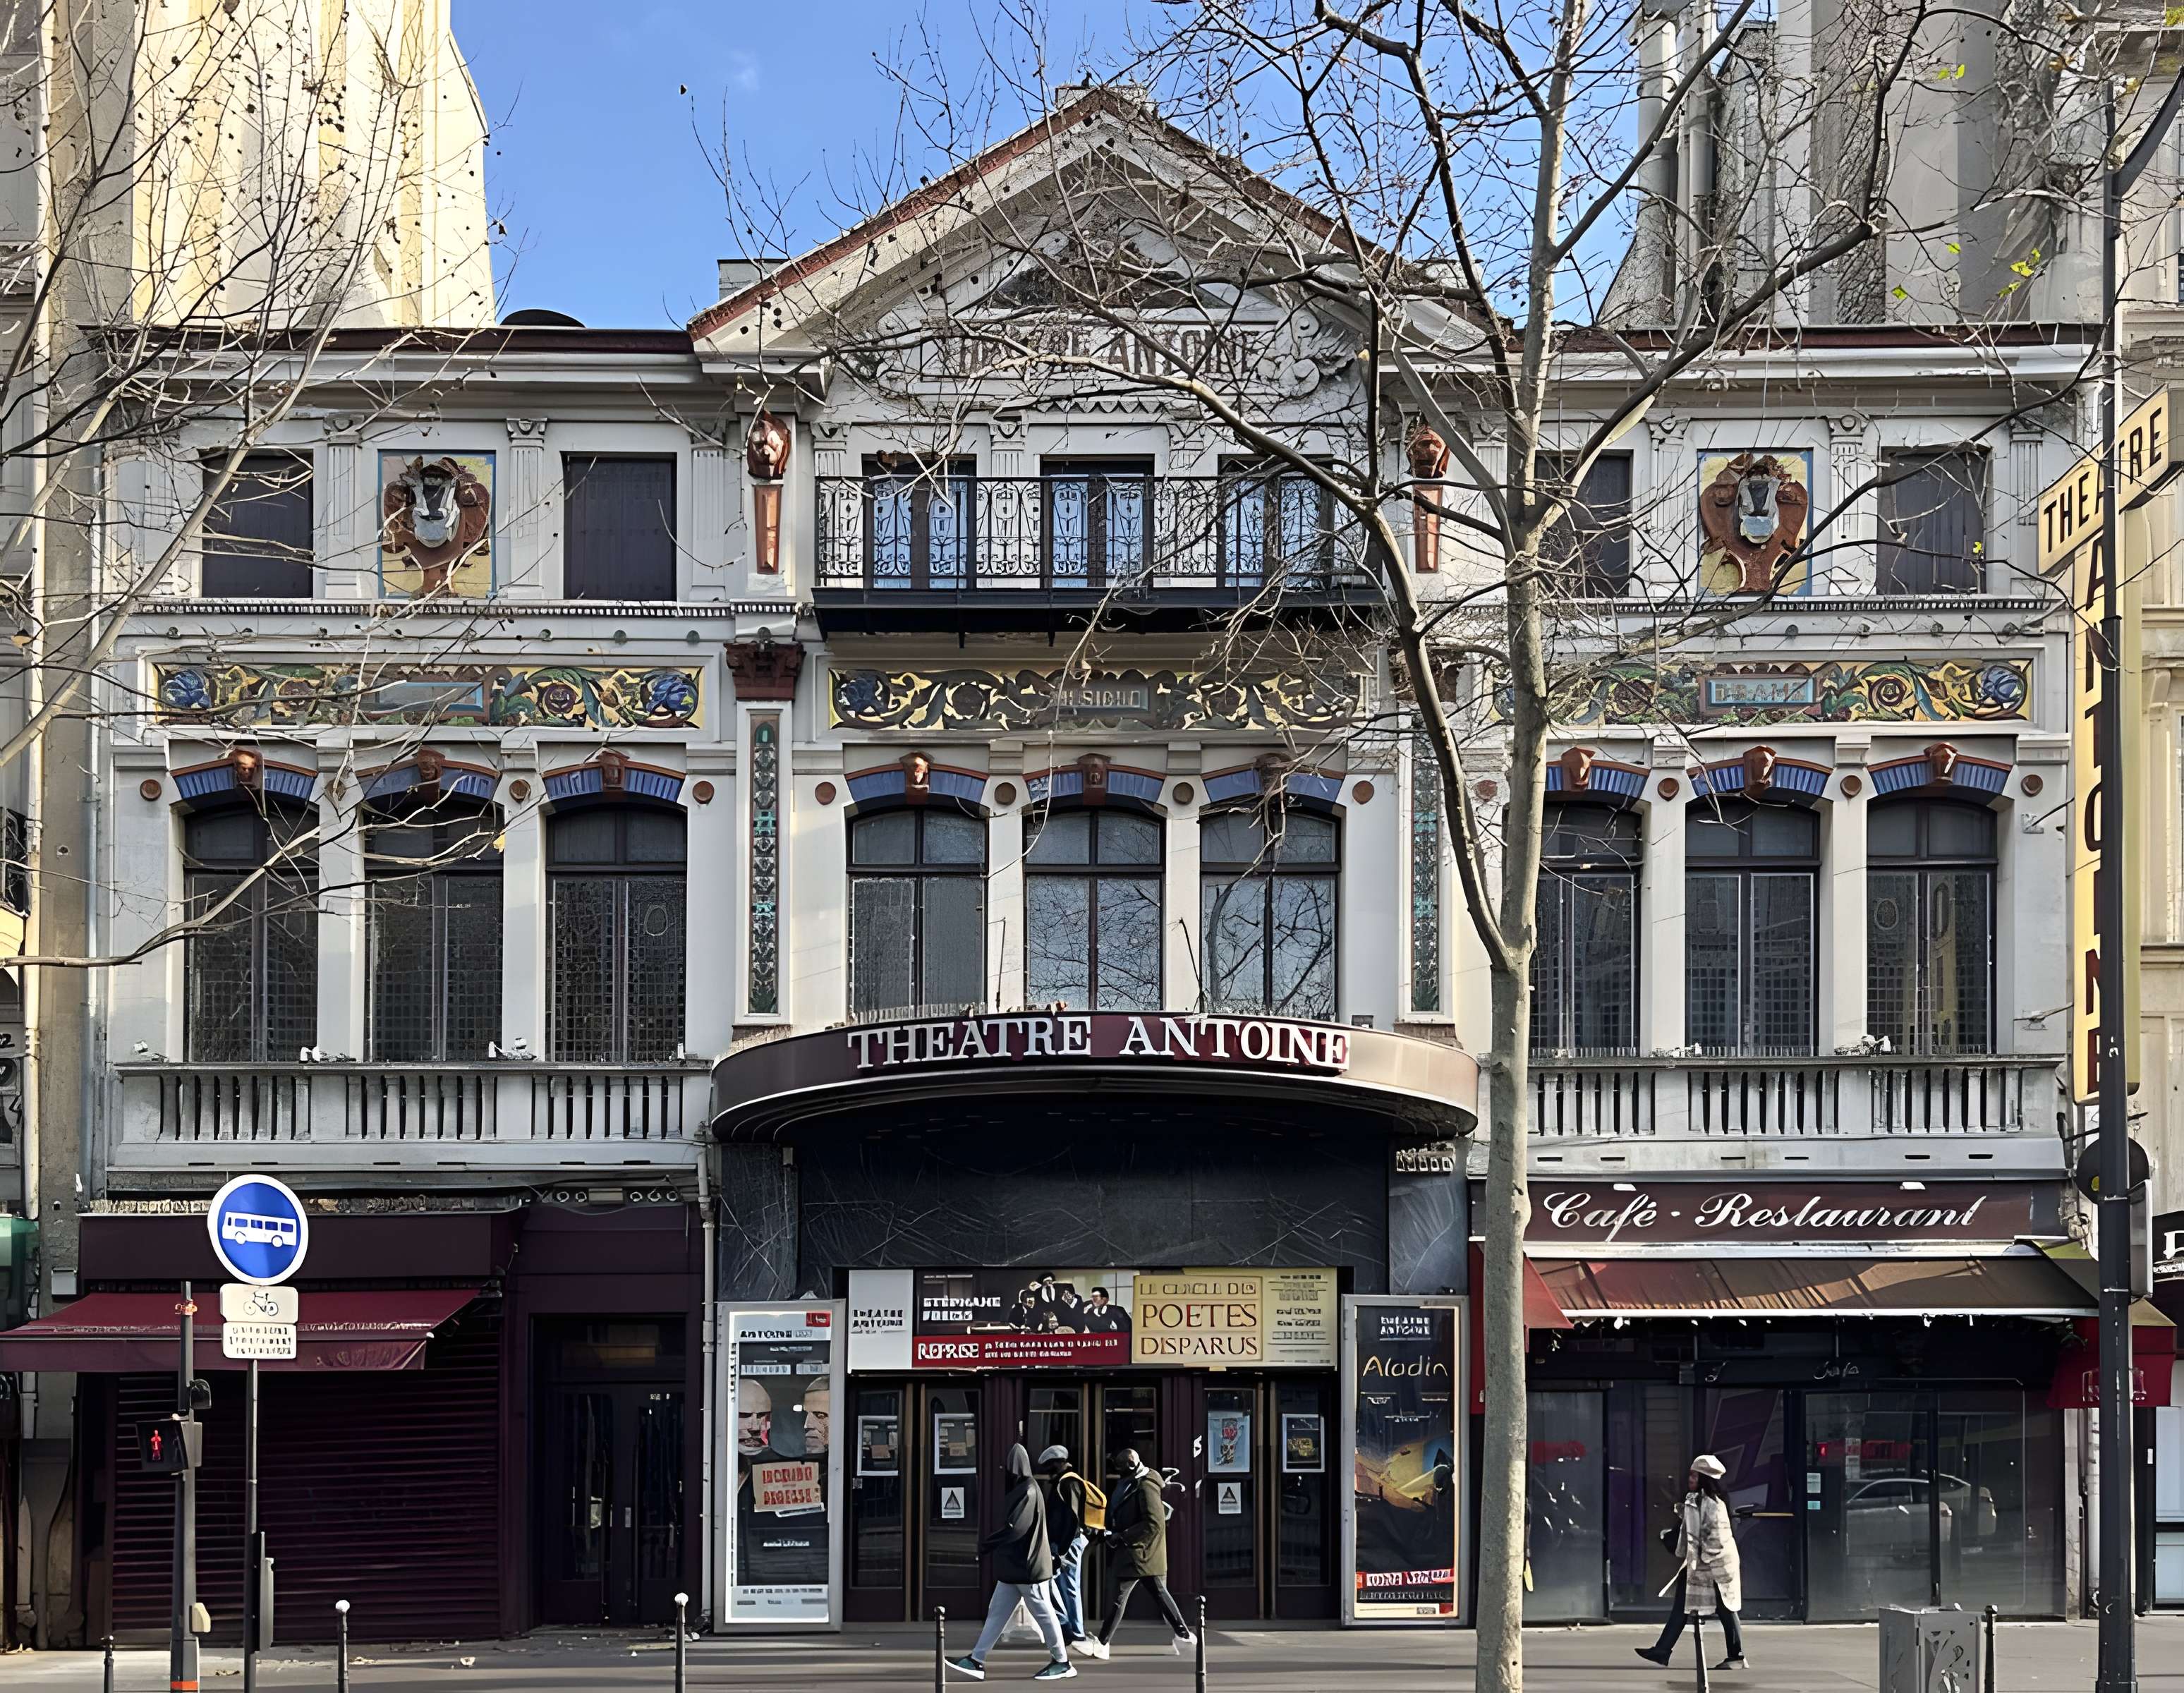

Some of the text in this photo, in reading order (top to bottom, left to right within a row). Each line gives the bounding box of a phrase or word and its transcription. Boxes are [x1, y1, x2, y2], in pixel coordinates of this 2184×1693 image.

[847, 1016, 1350, 1072] THEATRE ANTOINE
[1543, 1191, 1987, 1242] Café Restaurant
[1141, 1337, 1258, 1355] DISPARUS
[1363, 1355, 1448, 1376] Aladin
